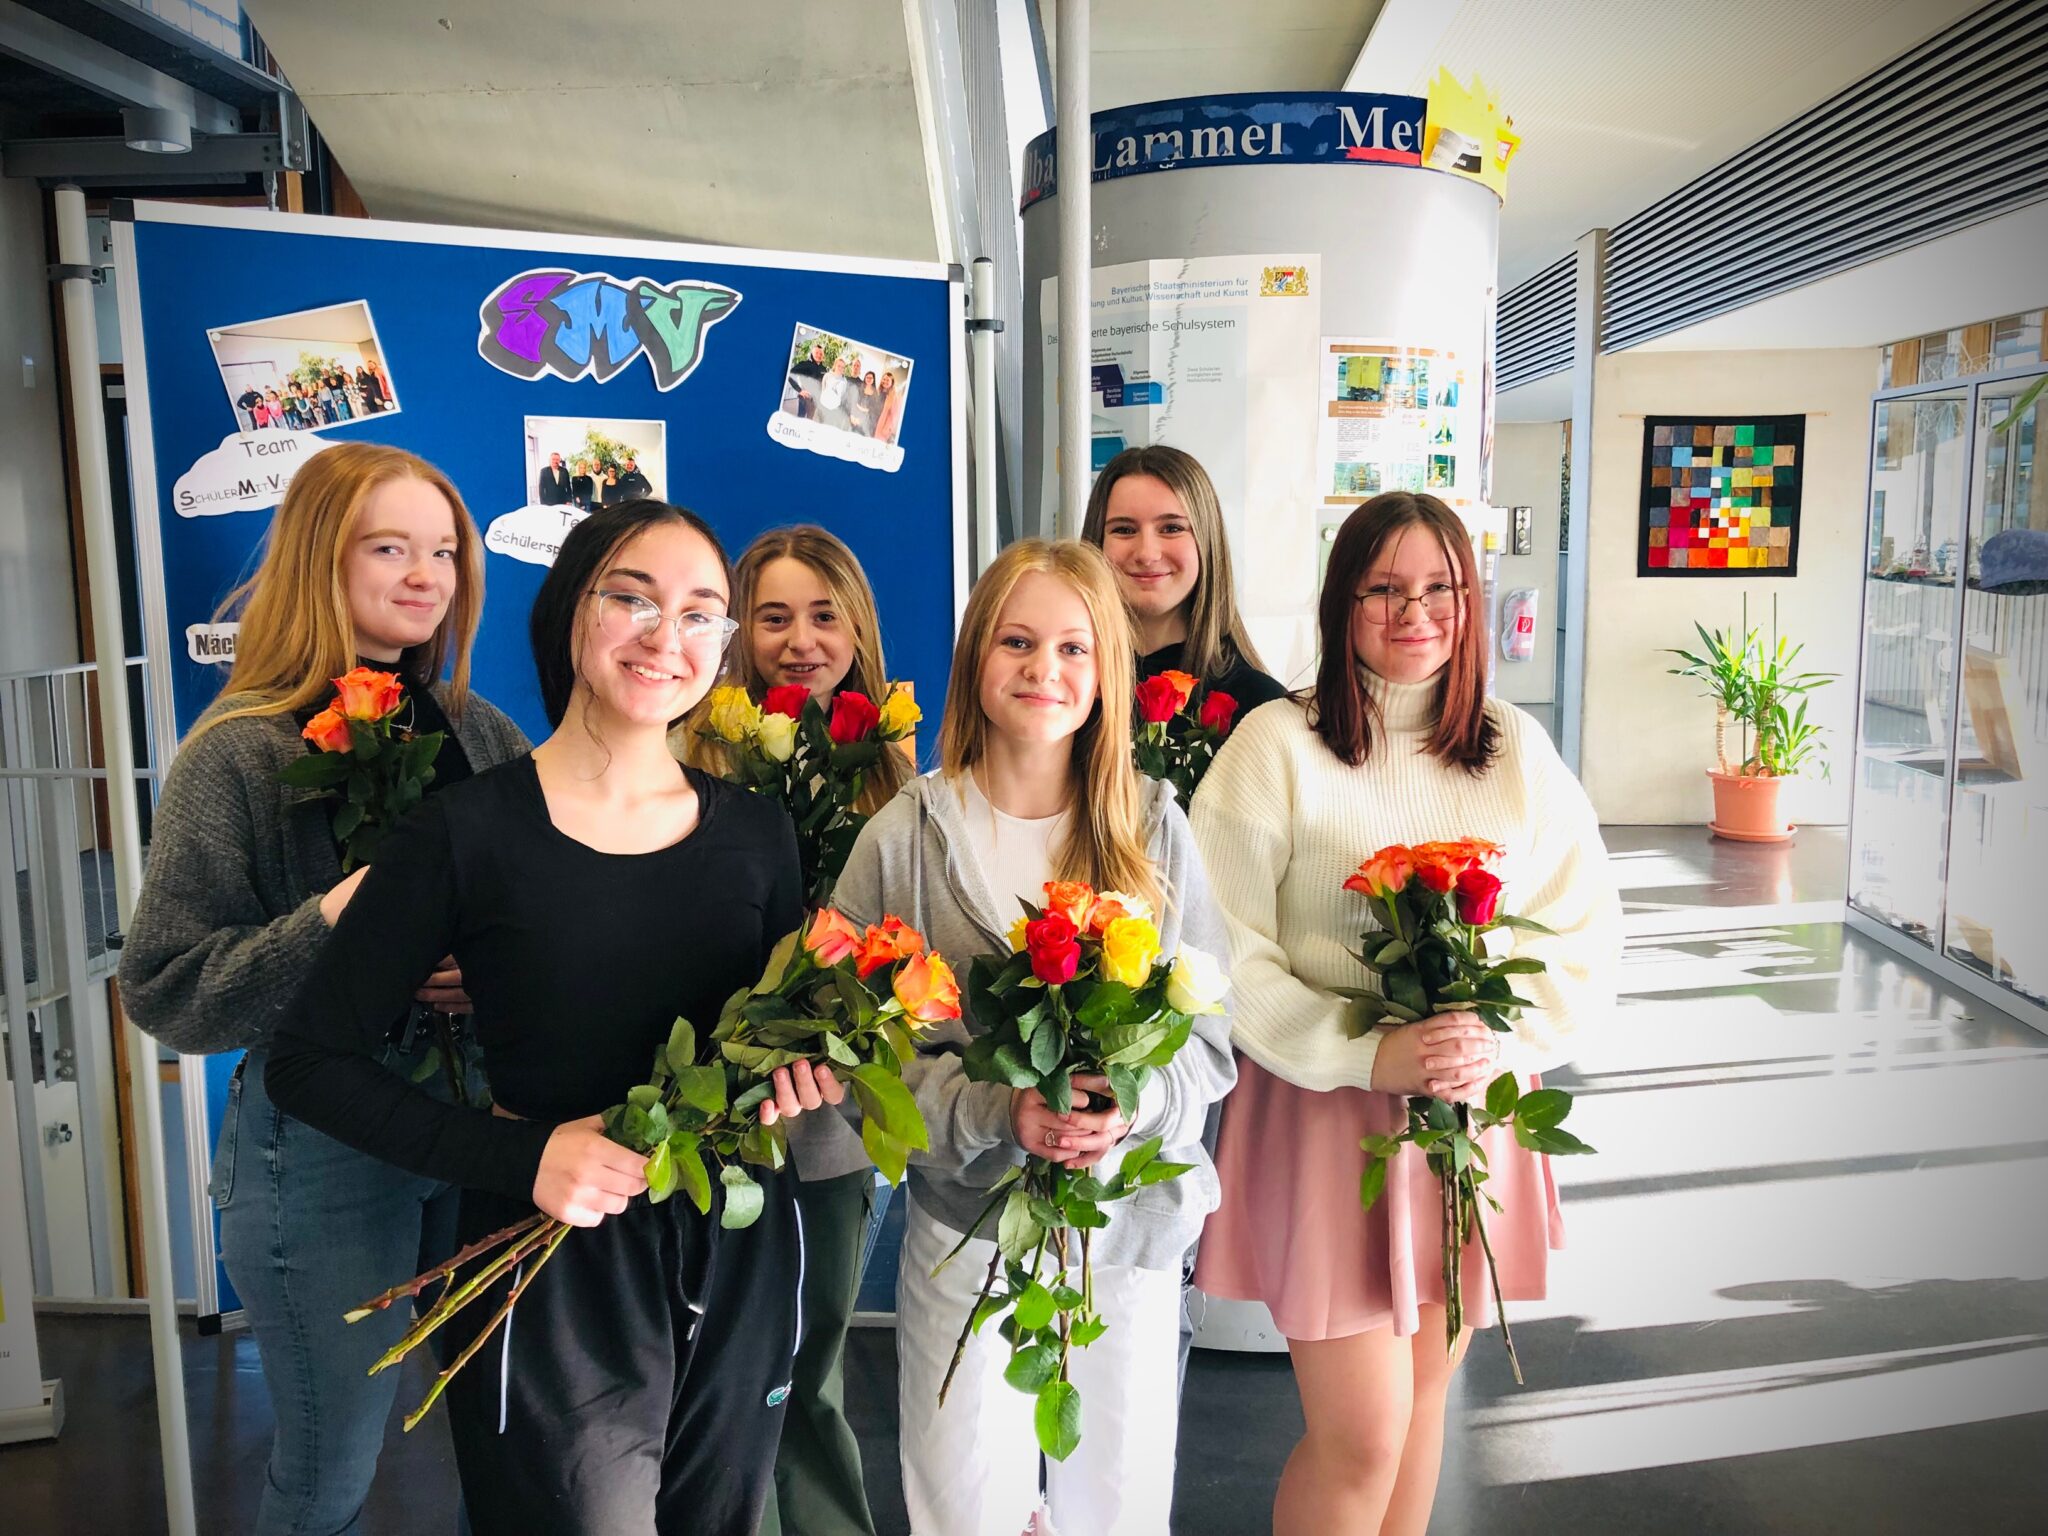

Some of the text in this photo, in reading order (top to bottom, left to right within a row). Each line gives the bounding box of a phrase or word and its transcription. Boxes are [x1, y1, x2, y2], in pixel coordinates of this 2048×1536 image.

[1145, 289, 1201, 301] Wissenschaft
[1203, 288, 1221, 298] und
[1223, 287, 1249, 298] Kunst
[1153, 279, 1234, 291] Staatsministerium
[484, 275, 738, 389] SMV
[1091, 328, 1108, 338] erte
[1110, 321, 1159, 337] bayerische
[1162, 318, 1236, 333] Schulsystem
[239, 438, 298, 458] Team
[559, 510, 580, 530] Te
[491, 530, 560, 558] Schülersp
